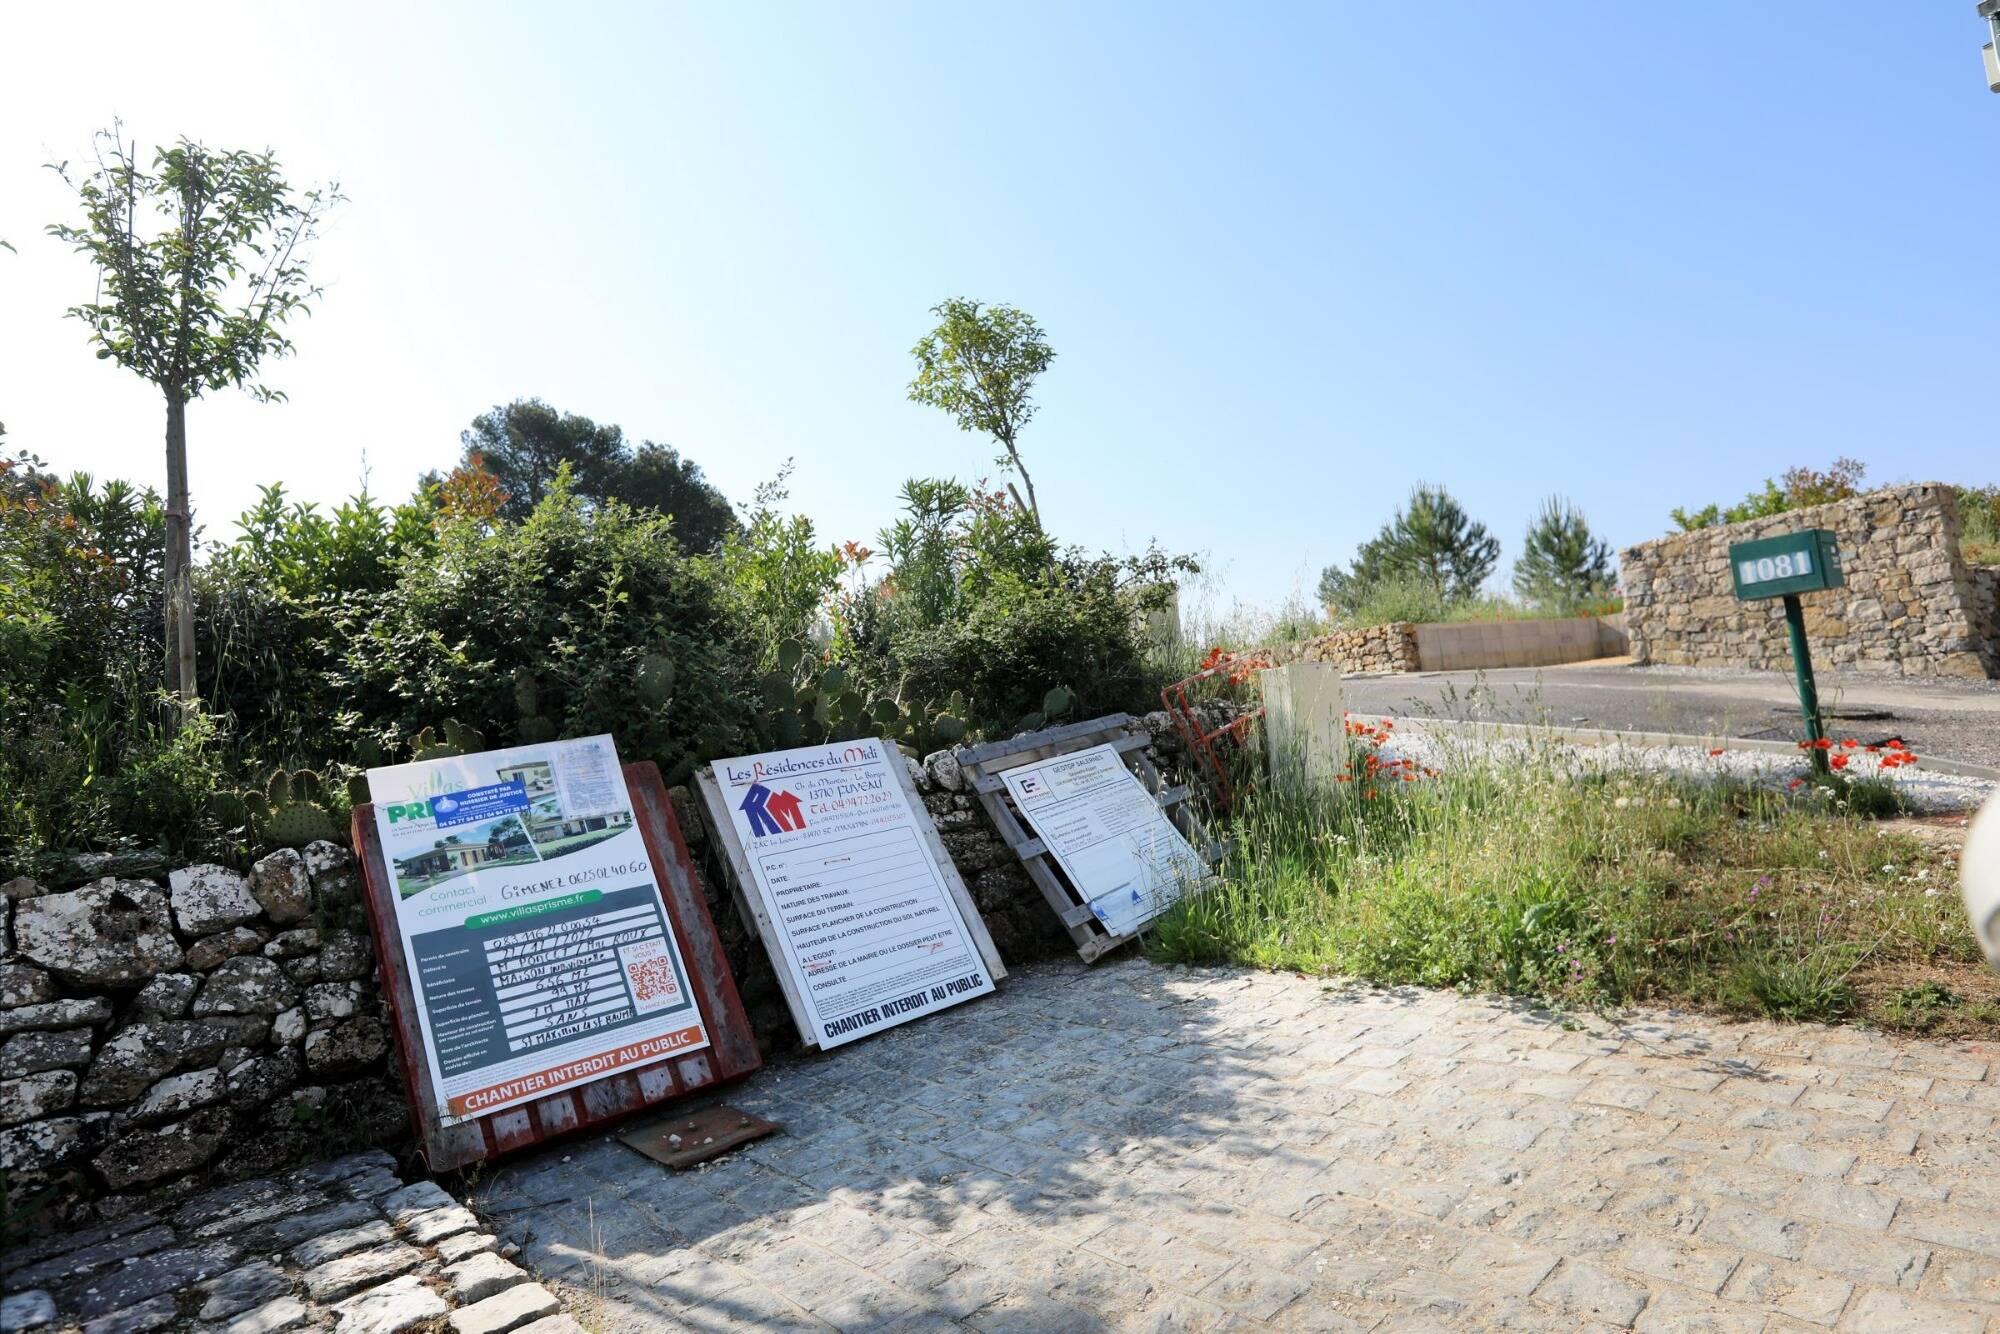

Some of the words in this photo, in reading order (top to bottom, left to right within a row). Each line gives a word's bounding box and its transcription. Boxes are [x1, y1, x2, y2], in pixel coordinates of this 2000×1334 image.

[1741, 552, 1809, 584] 1081
[726, 766, 751, 781] Les
[753, 758, 824, 778] Résidences
[826, 751, 842, 765] du
[843, 745, 877, 762] Midi
[498, 789, 522, 797] JUSTICE
[837, 779, 882, 795] FUVEAU
[429, 885, 475, 901] Contact
[780, 899, 806, 909] NATURE
[806, 895, 820, 903] DES
[418, 896, 486, 916] commercial
[481, 895, 582, 922] www.villasprisme.fr
[786, 911, 815, 923] SURFACE
[791, 924, 820, 936] SURFACE
[821, 915, 854, 927] PLANCHER
[796, 936, 827, 949] HAUTEUR
[846, 919, 892, 935] CONSTRUCTION
[914, 906, 939, 916] NATUREL
[808, 963, 836, 977] ADRESSE
[837, 960, 847, 968] DE
[847, 957, 857, 965] LA
[856, 951, 877, 961] MAIRIE
[878, 948, 888, 956] OU
[896, 938, 922, 950] DOSSIER
[921, 933, 936, 942] PEUT
[824, 1008, 880, 1037] CHANTIER
[881, 991, 928, 1017] INTERDIT
[931, 985, 946, 1001] AU
[946, 973, 982, 995] PUBLIC
[465, 1075, 544, 1108] CHANTIER
[548, 1054, 613, 1082] INTERDIT
[619, 1047, 638, 1062] AU
[641, 1032, 689, 1054] PUBLIC
